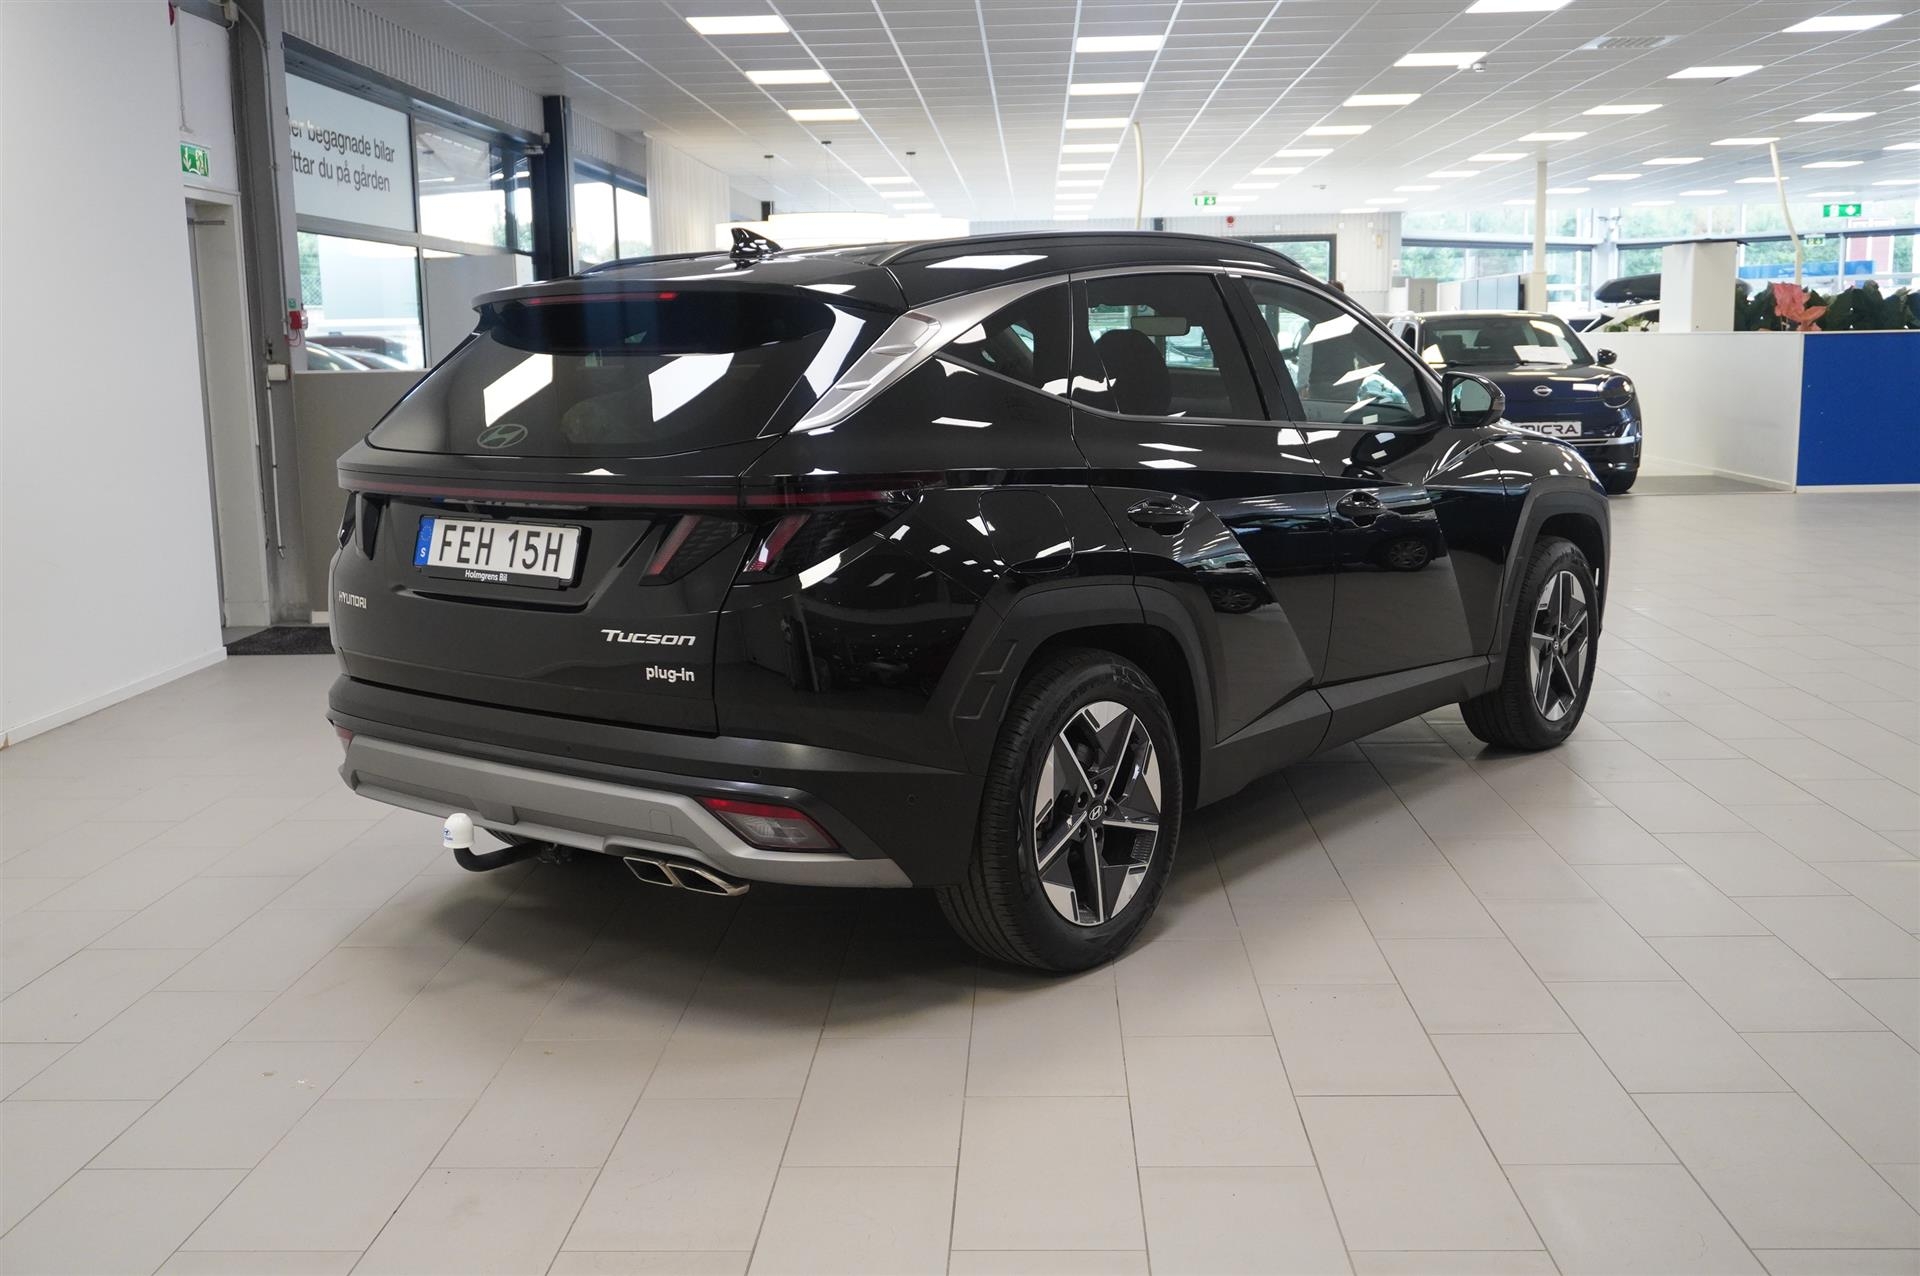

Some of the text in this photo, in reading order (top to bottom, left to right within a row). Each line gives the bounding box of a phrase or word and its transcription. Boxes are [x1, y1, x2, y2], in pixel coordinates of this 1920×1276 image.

[307, 120, 371, 157] begagnade
[373, 138, 395, 162] bilar
[318, 156, 333, 180] du
[336, 159, 351, 186] på
[353, 163, 391, 192] gården
[1520, 424, 1579, 435] MICRA
[420, 547, 426, 558] S
[438, 524, 564, 573] FEH 15H
[464, 569, 508, 583] Holmgrens Bil
[338, 590, 367, 609] HYUNDAI
[645, 665, 695, 683] plug-in
